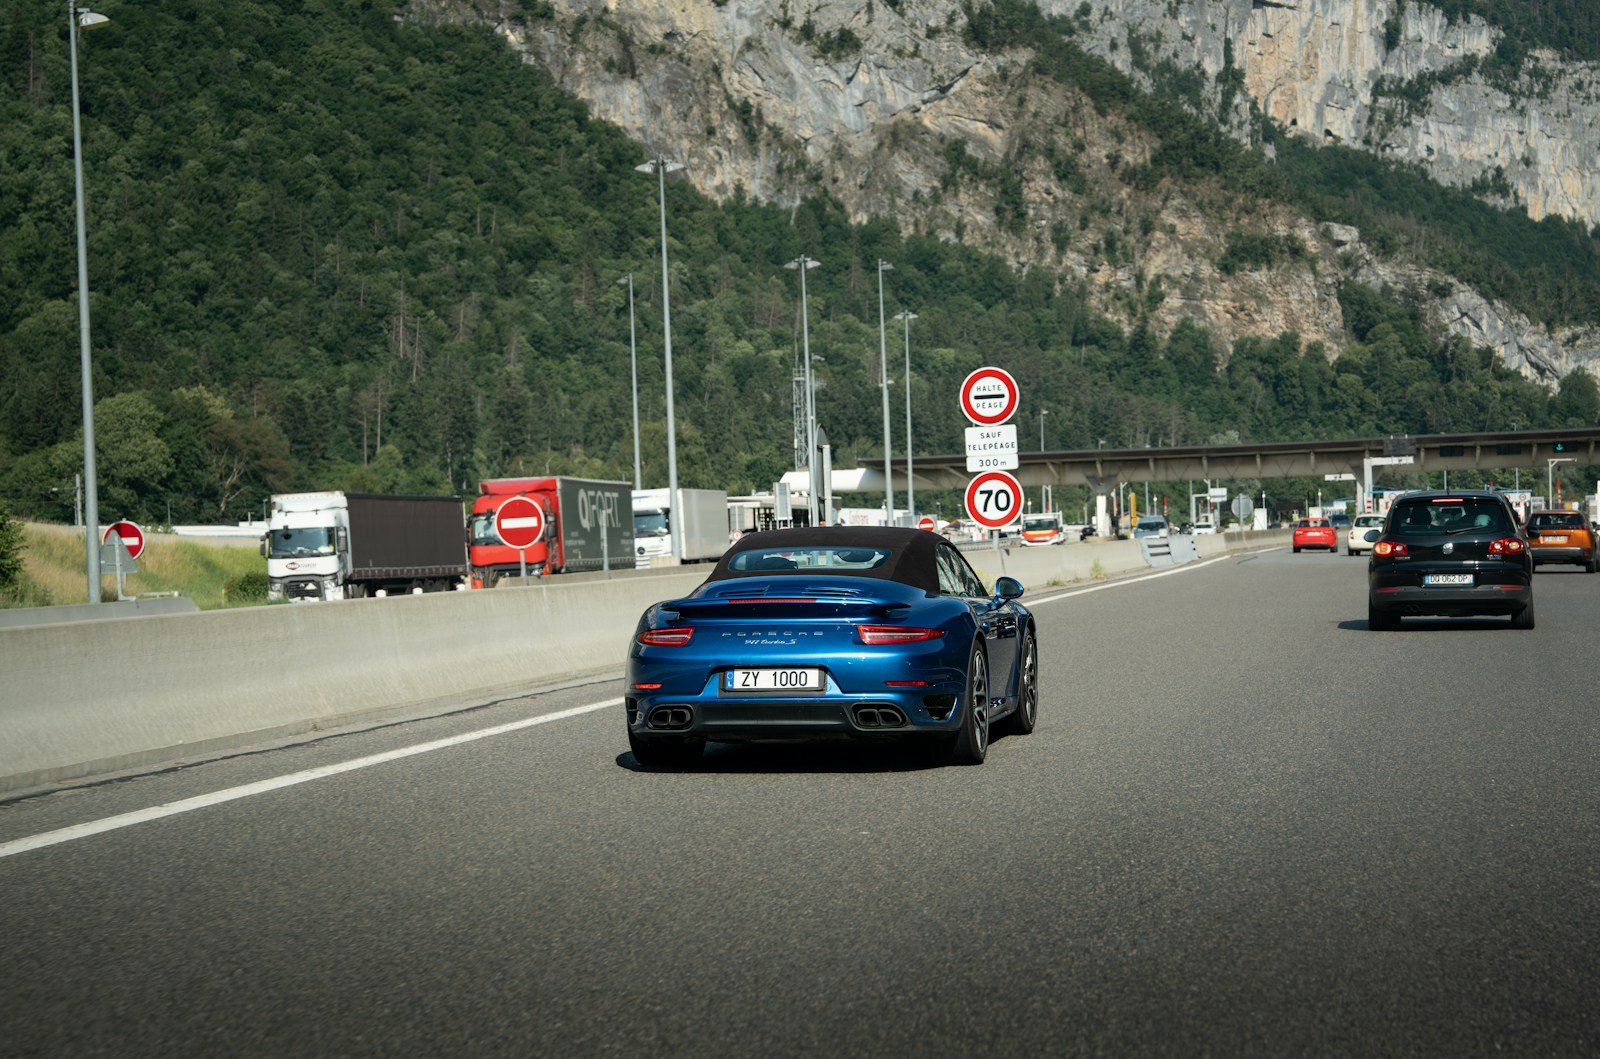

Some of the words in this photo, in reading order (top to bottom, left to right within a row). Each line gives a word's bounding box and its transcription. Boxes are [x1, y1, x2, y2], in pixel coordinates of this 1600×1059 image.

[976, 384, 1002, 392] HALTE
[980, 431, 1002, 440] SAUF
[978, 458, 999, 467] 300
[980, 490, 1010, 512] 70
[741, 671, 760, 687] ZY
[772, 671, 808, 687] 1000
